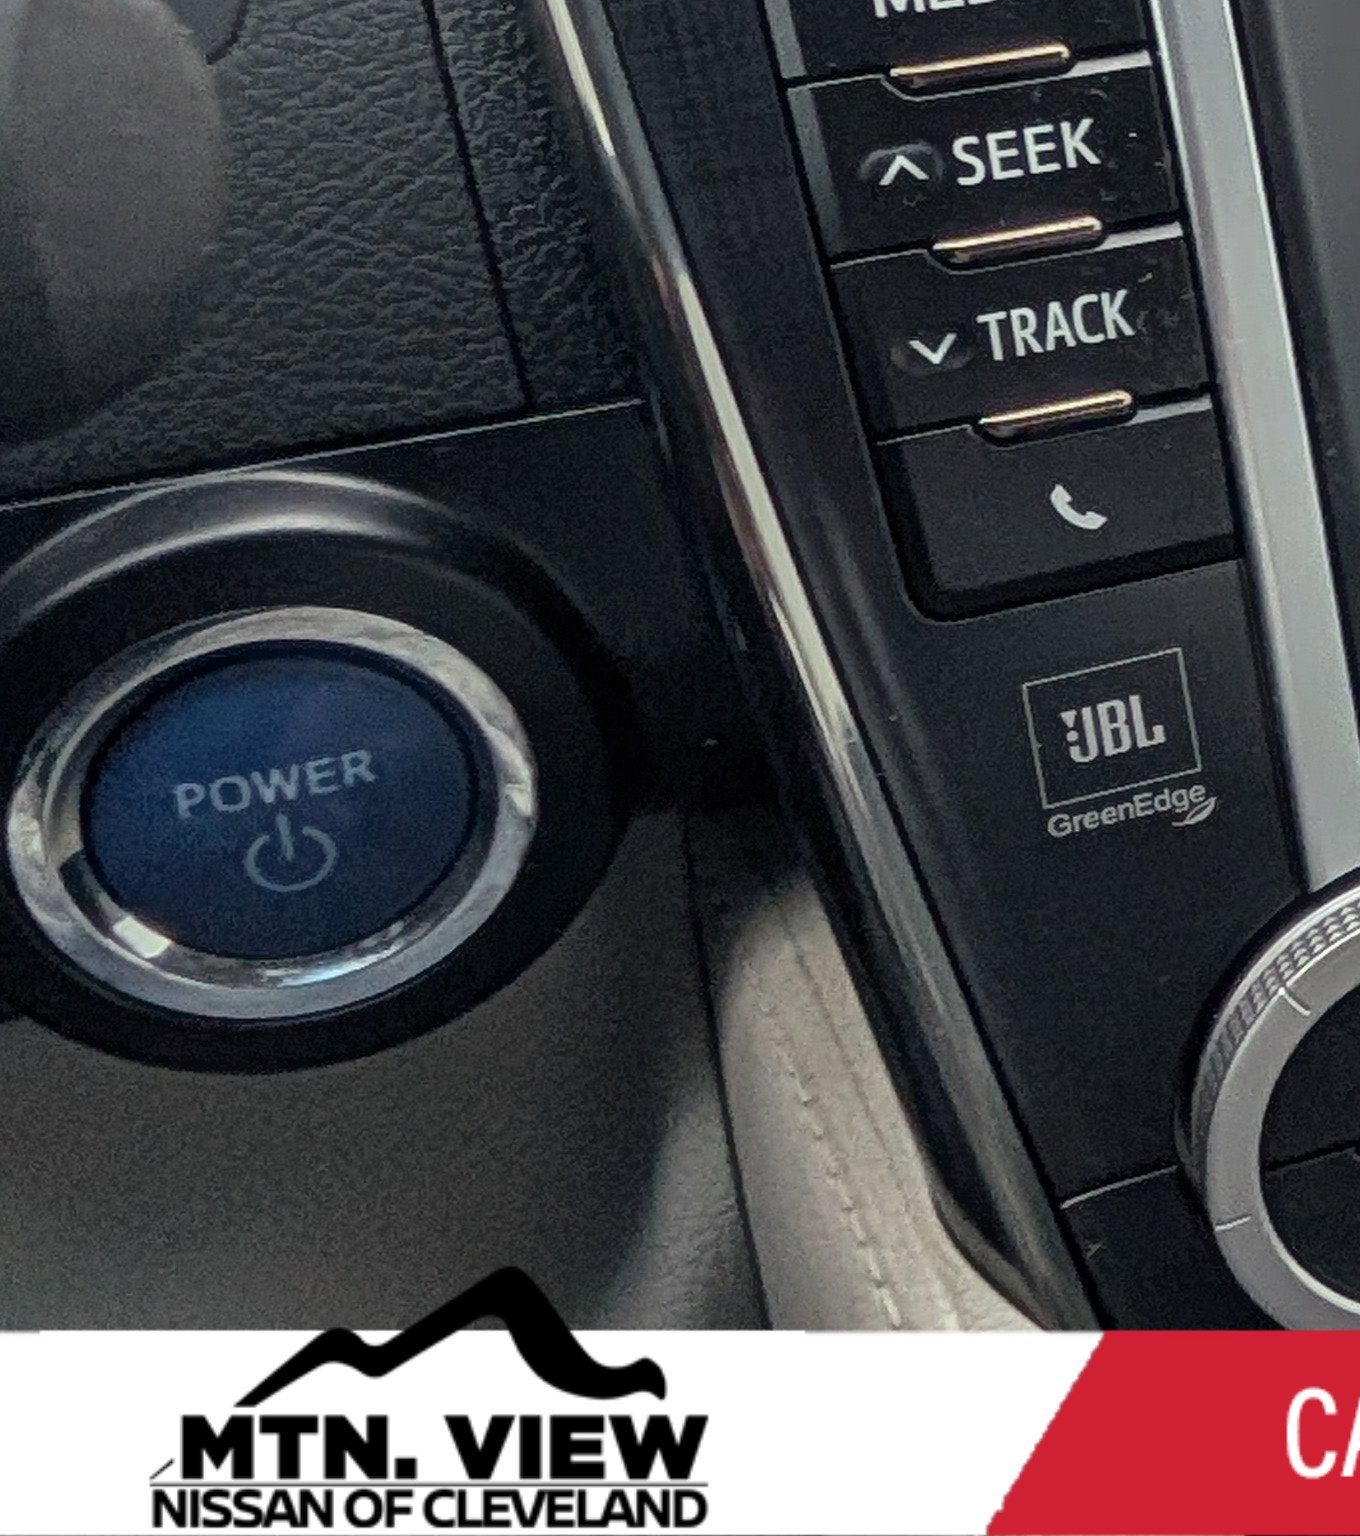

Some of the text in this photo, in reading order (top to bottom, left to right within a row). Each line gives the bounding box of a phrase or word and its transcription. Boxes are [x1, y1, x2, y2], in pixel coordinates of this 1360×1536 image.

[952, 118, 1101, 186] SEEK
[976, 289, 1135, 362] TRACK
[1061, 694, 1167, 763] JBL
[173, 749, 376, 819] POWER
[1047, 784, 1206, 838] GreenEdge
